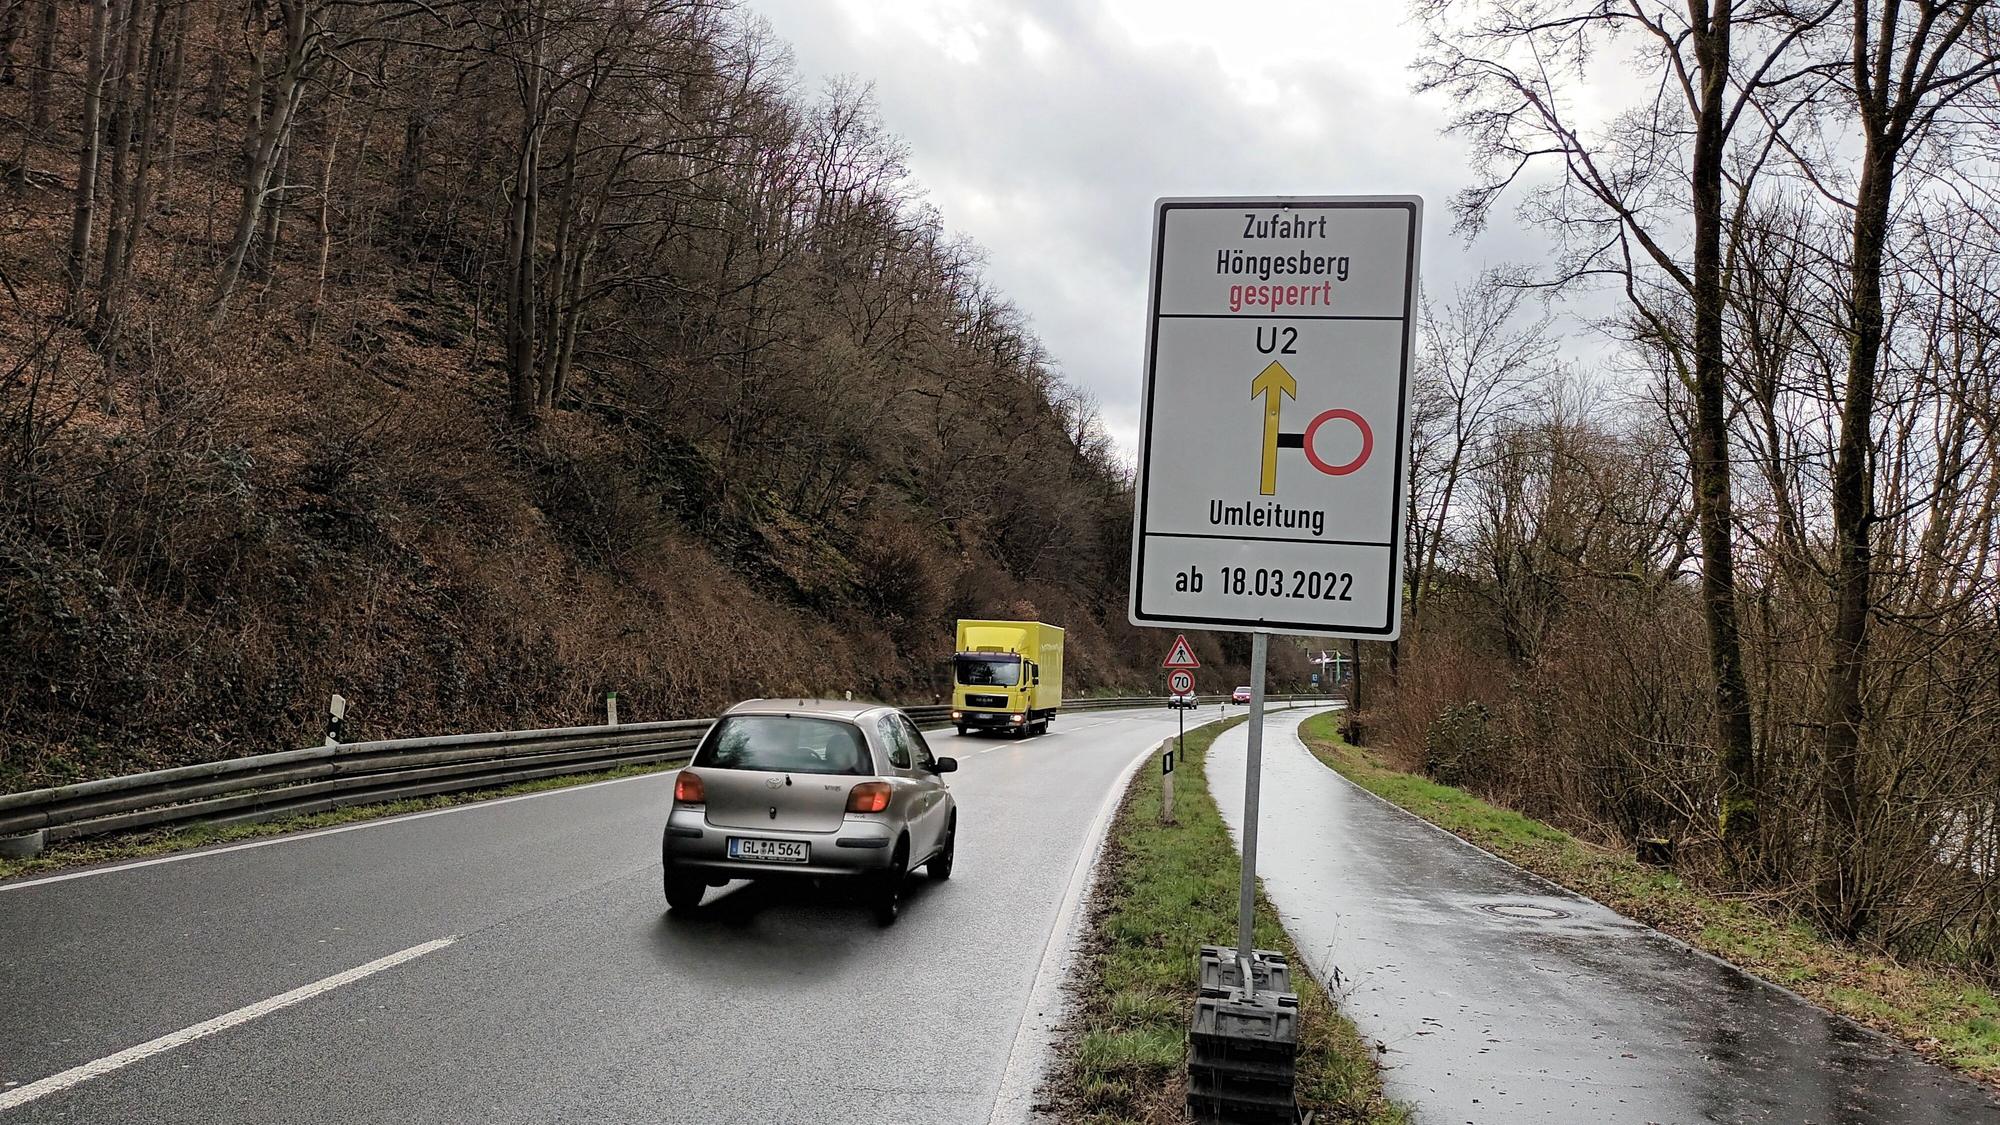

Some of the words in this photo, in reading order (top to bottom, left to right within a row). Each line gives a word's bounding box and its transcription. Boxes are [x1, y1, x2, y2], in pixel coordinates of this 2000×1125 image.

[1244, 214, 1327, 239] Zufahrt
[1217, 250, 1350, 282] Höngesberg
[1229, 280, 1332, 312] gesperrt
[1256, 327, 1298, 355] U2
[1210, 500, 1325, 536] Umleitung
[1175, 566, 1204, 593] ab
[1221, 567, 1354, 602] 18.03.2022
[1174, 676, 1189, 689] 70
[743, 840, 759, 854] GL
[767, 842, 775, 855] A
[778, 843, 801, 857] 564
